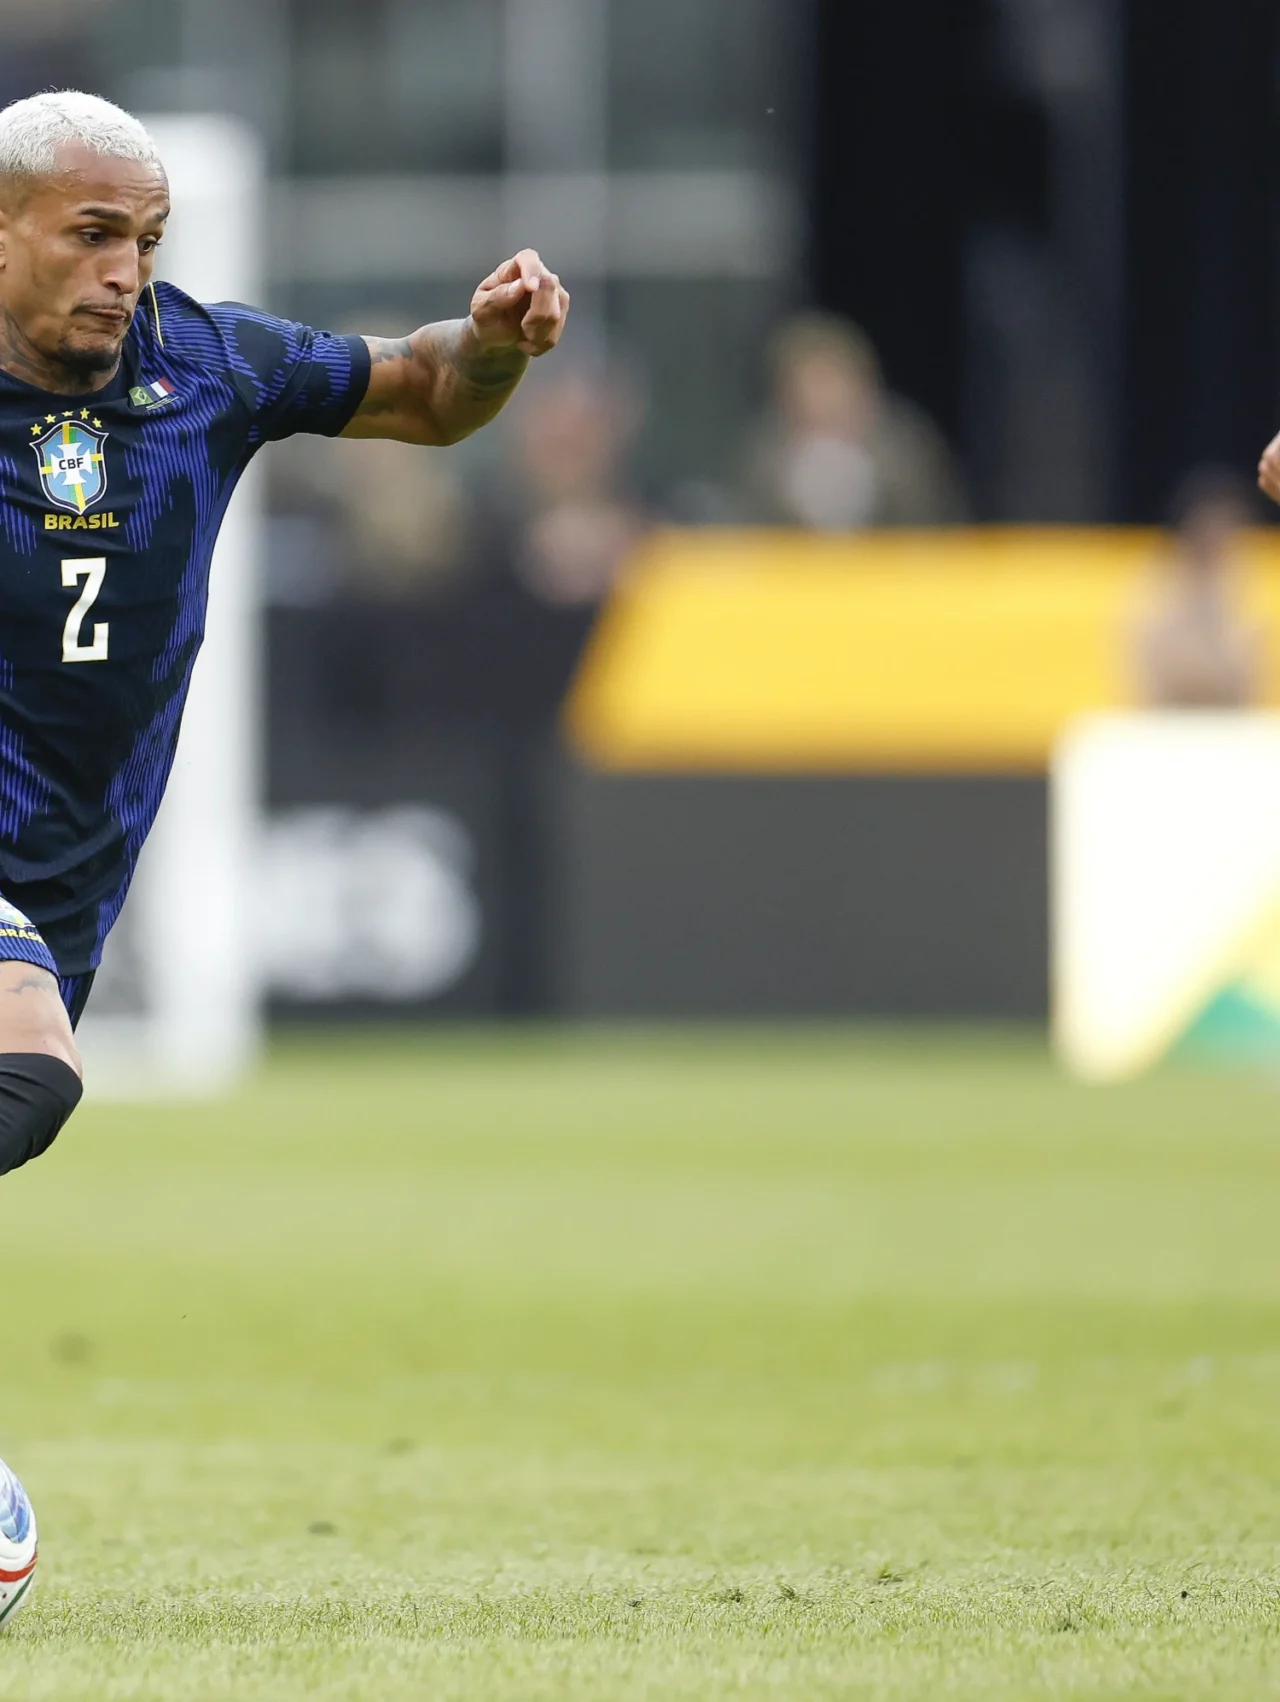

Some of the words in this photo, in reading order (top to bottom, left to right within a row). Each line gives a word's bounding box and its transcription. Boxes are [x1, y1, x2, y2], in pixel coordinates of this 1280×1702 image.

[59, 457, 84, 470] CBF
[44, 512, 120, 530] BRASIL
[61, 557, 109, 663] 2
